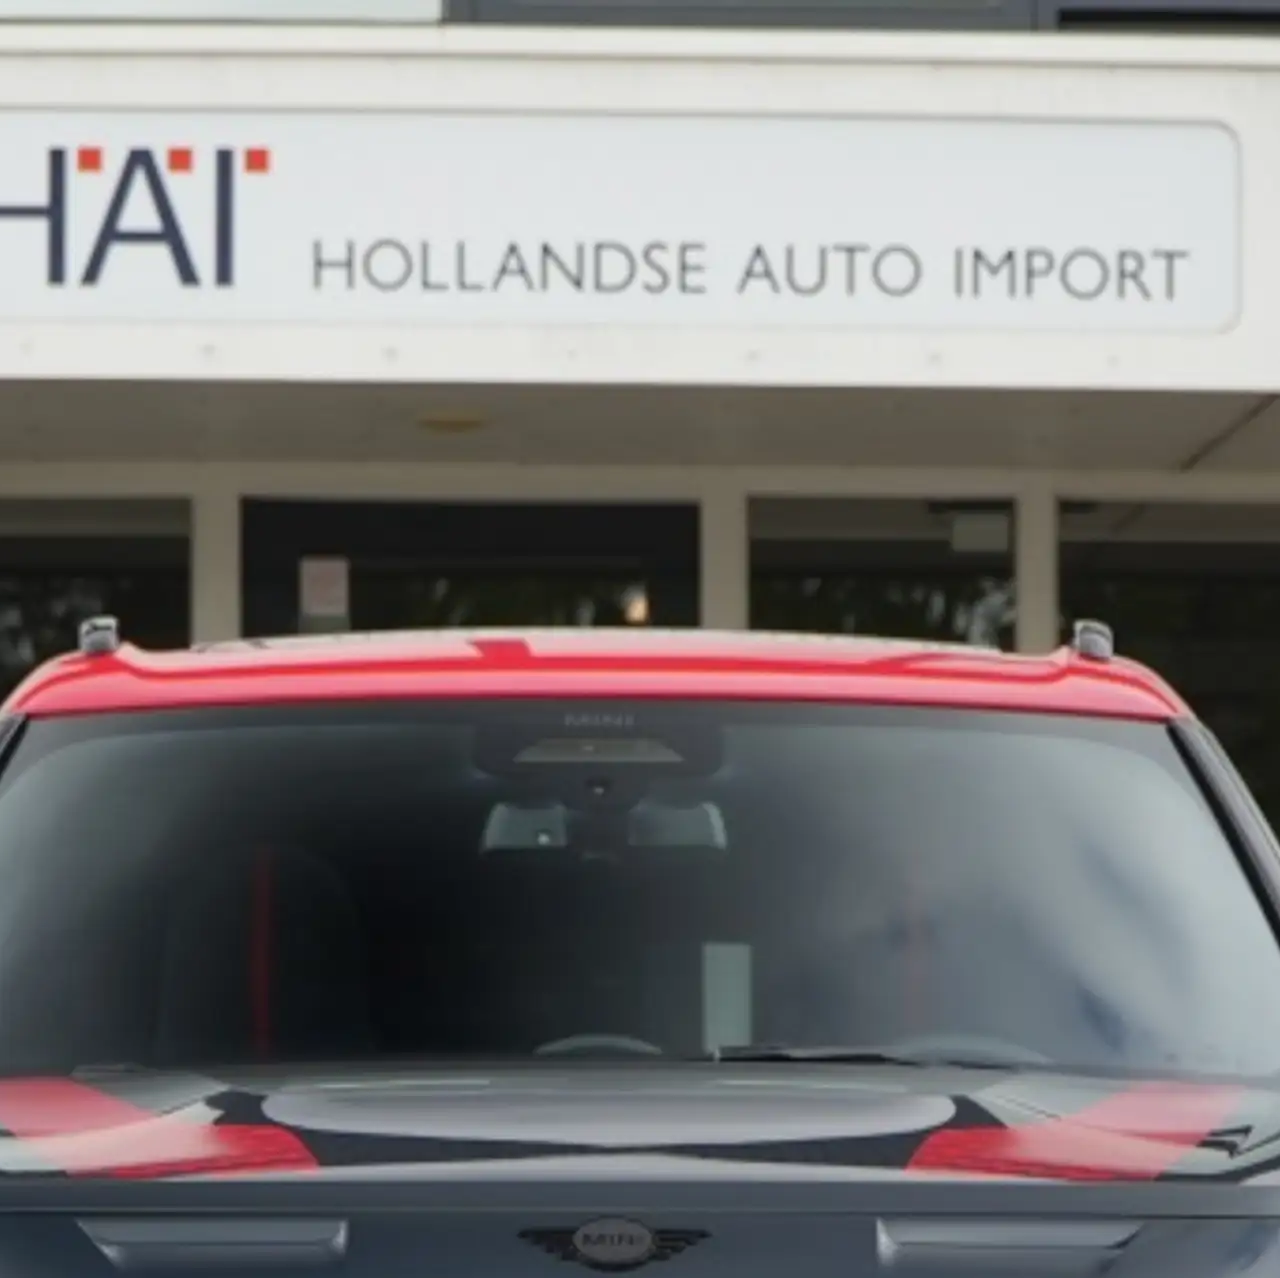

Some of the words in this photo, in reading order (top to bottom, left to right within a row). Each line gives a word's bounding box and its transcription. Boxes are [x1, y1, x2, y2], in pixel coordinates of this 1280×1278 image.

[313, 237, 707, 295] HOLLANDSE
[735, 243, 923, 297] AUTO
[954, 247, 1188, 301] IMPORT
